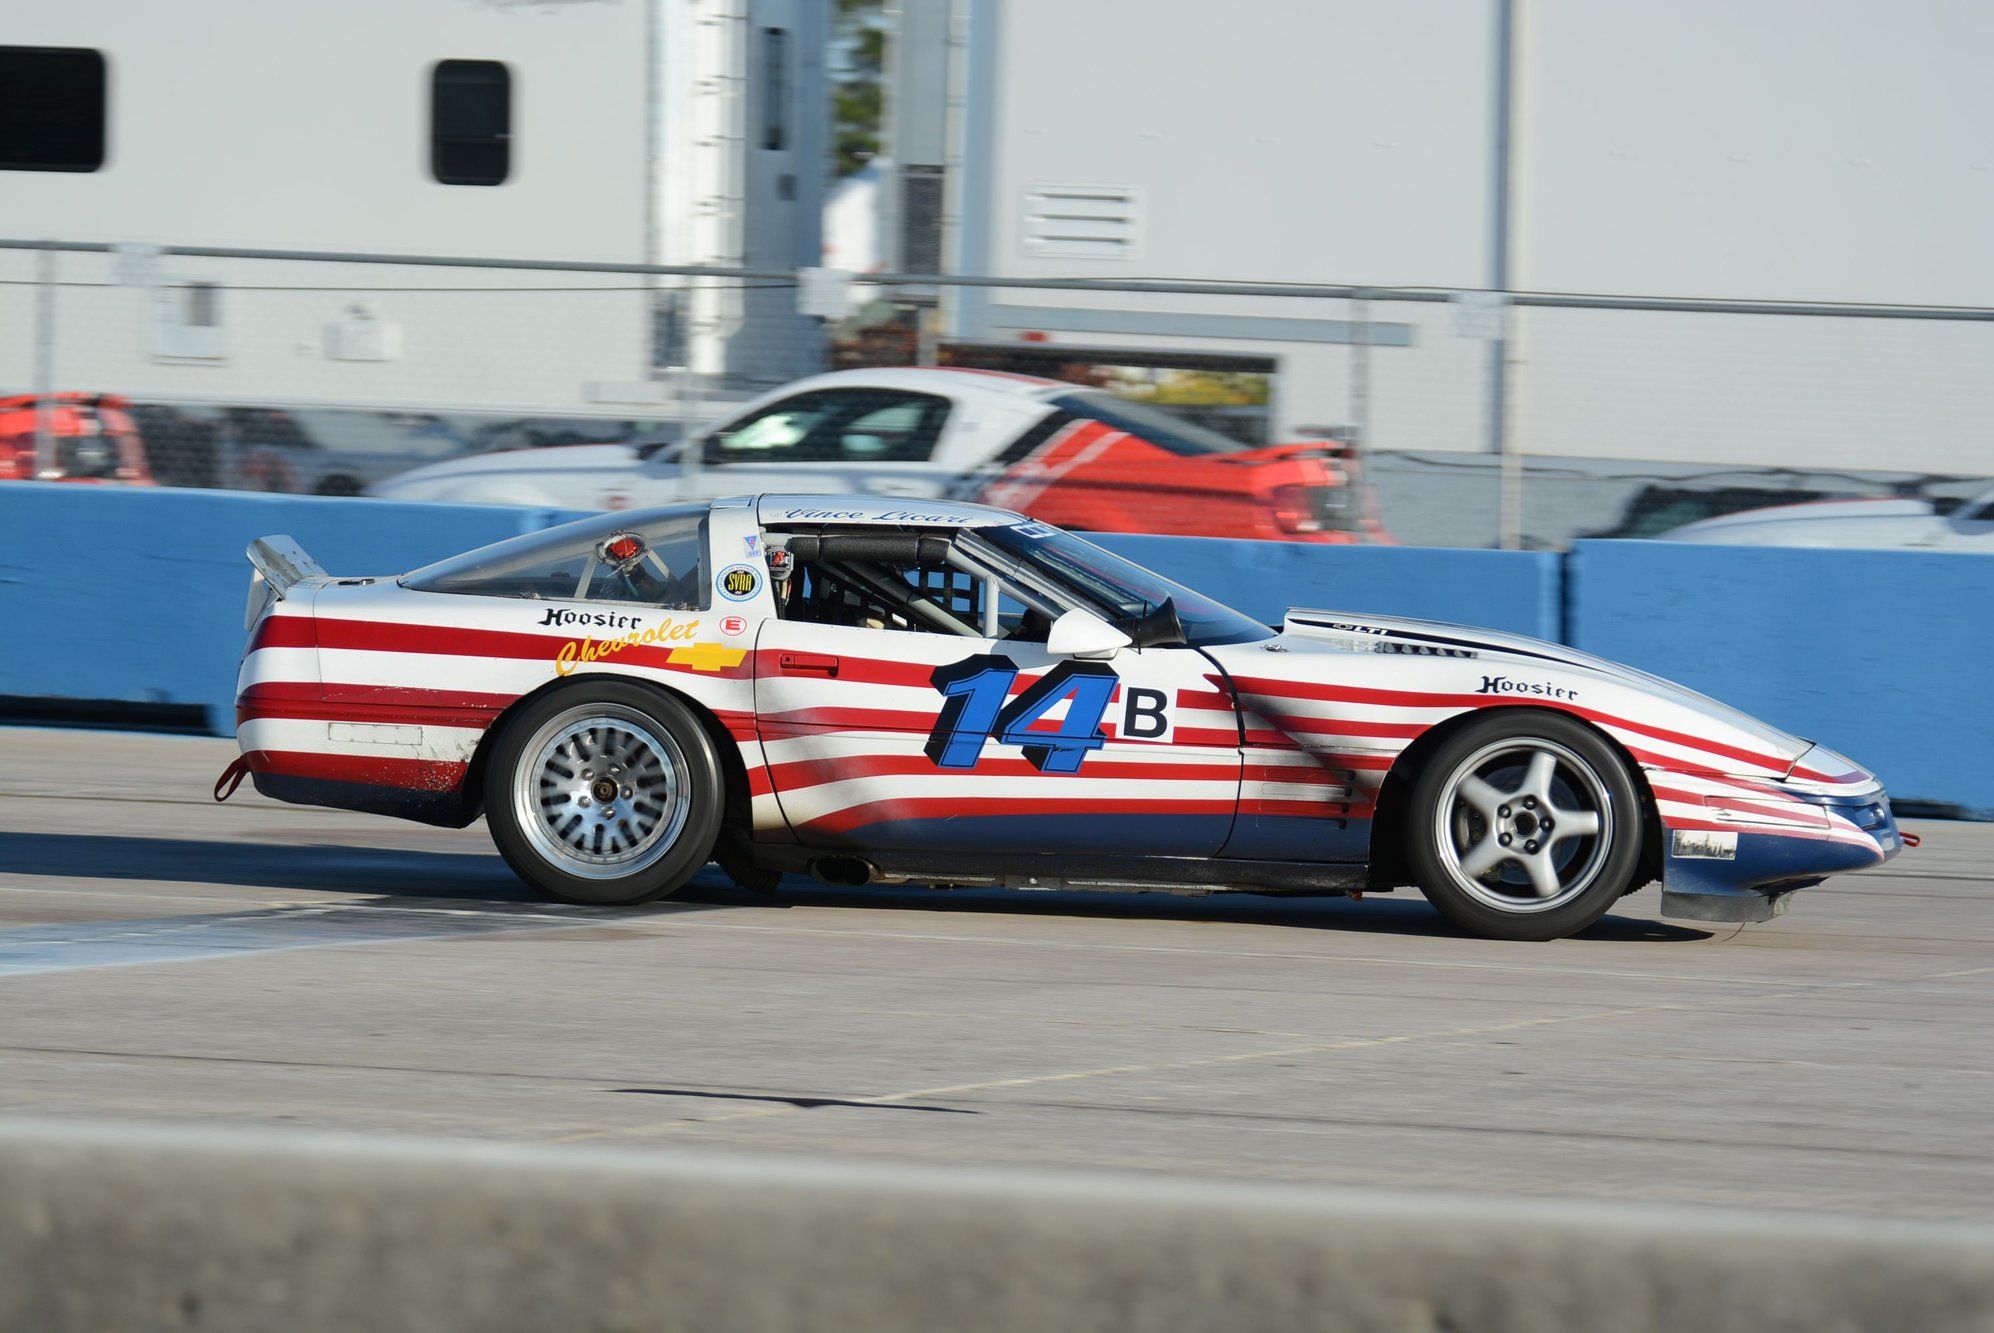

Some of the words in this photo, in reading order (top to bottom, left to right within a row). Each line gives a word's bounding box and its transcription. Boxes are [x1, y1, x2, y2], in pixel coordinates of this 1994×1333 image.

[785, 508, 864, 519] Vince
[727, 573, 752, 591] SVRA
[538, 608, 642, 629] Hoosier
[725, 619, 741, 630] E
[555, 618, 700, 677] Chevrolet
[1475, 676, 1579, 701] Hoosier
[923, 653, 1120, 774] 14
[1123, 687, 1168, 739] B
